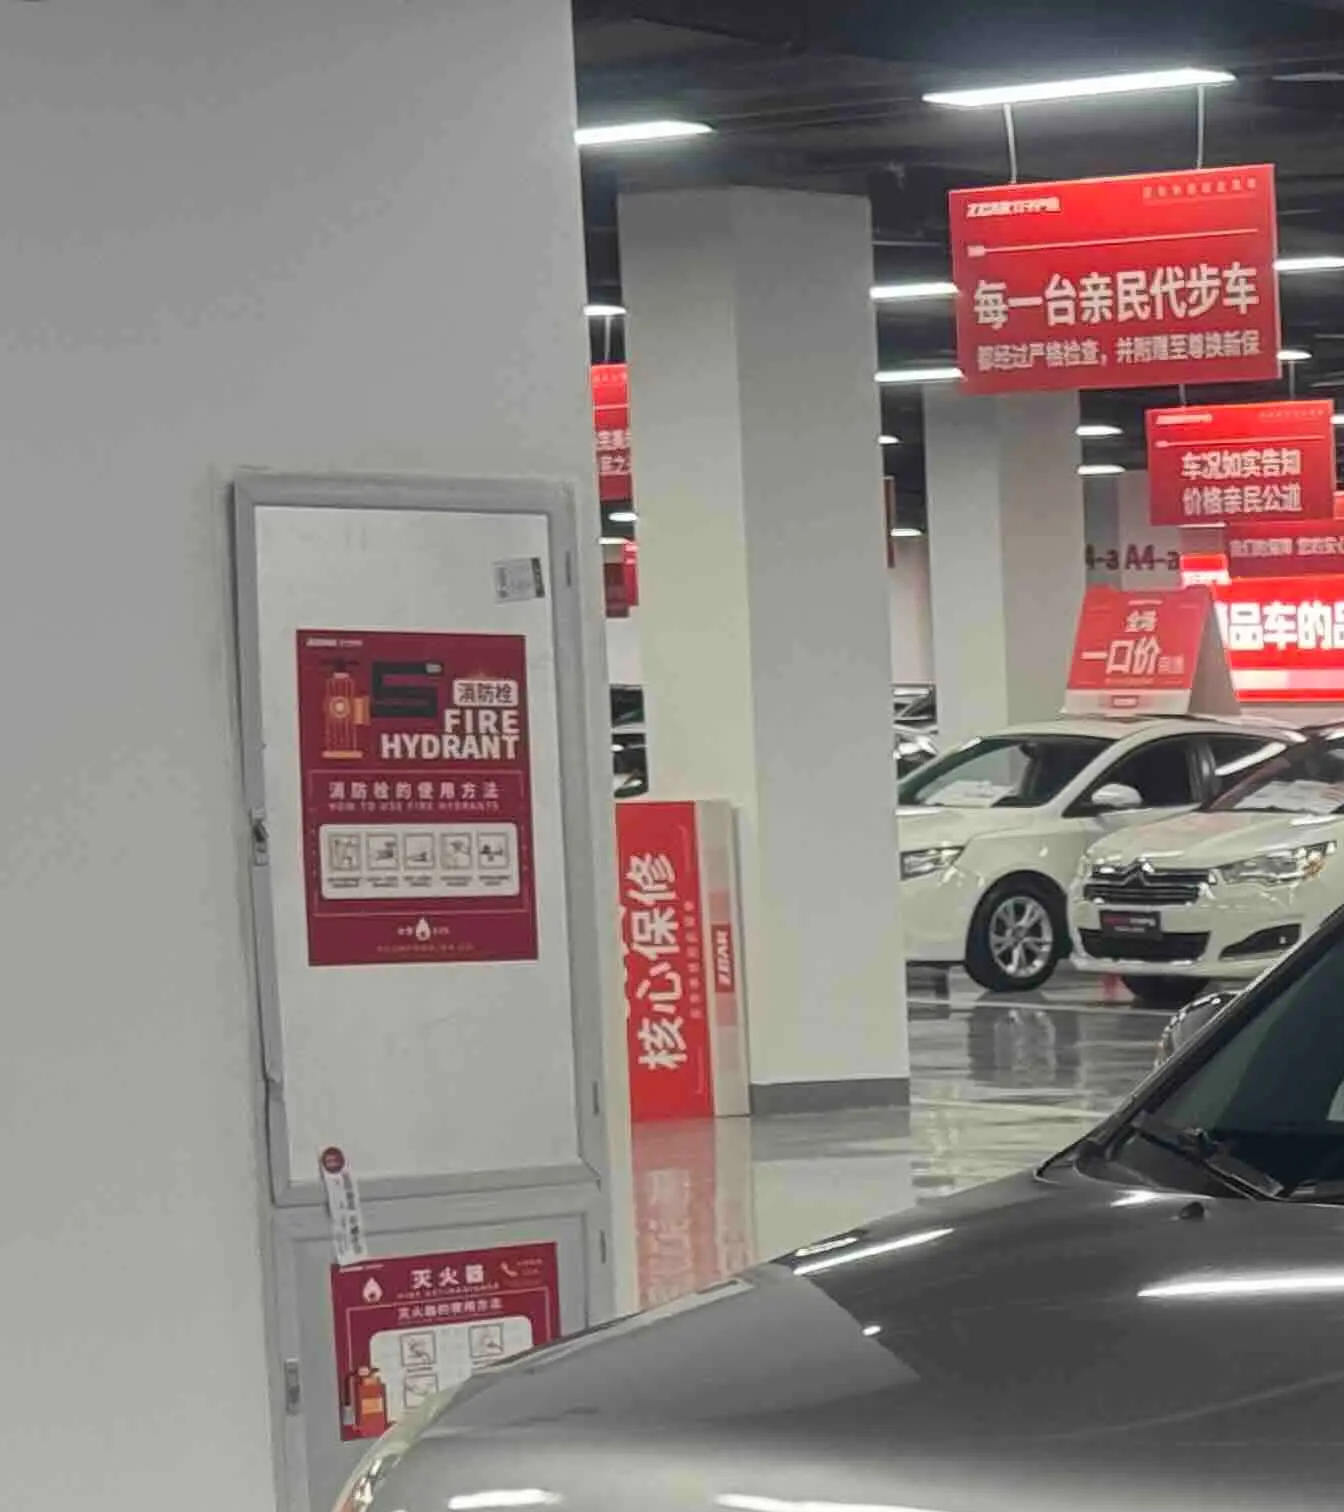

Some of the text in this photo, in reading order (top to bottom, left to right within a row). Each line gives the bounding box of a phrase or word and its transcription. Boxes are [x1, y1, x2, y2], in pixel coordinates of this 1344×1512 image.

[973, 262, 1260, 330] 每一台亲民代步车
[1181, 448, 1301, 480] 车况如实告知
[1182, 482, 1302, 515] 价格亲民公道
[1081, 635, 1161, 675] 一口价
[458, 682, 513, 704] 消防栓
[443, 708, 520, 734] FIRE
[380, 733, 520, 760] HYDRANT
[625, 852, 688, 1070] 核心保修
[409, 1263, 485, 1289] 灭火器
